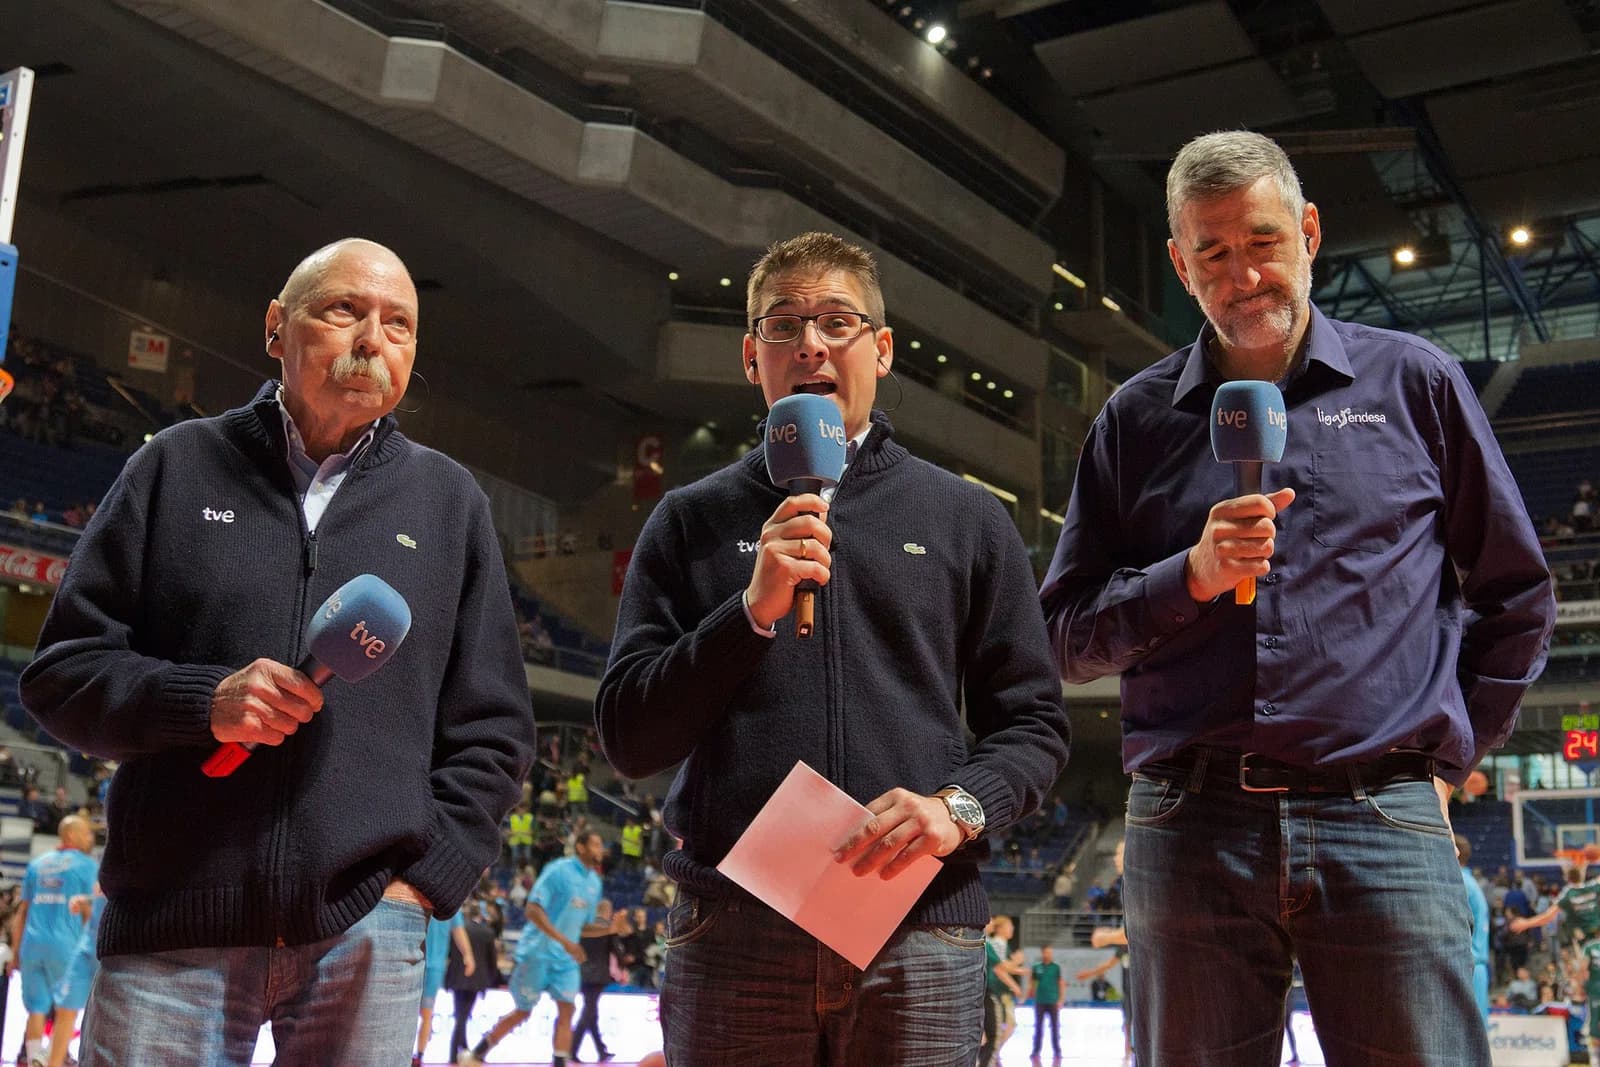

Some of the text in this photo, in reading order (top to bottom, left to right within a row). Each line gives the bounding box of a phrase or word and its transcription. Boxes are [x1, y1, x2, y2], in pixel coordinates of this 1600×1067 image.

[1216, 407, 1248, 430] tve
[1266, 406, 1287, 431] tve
[1316, 407, 1387, 426] liga endesa
[768, 422, 798, 445] tve
[818, 418, 845, 447] tve
[202, 506, 236, 523] tve
[349, 620, 386, 660] tve
[1565, 730, 1598, 760] 24
